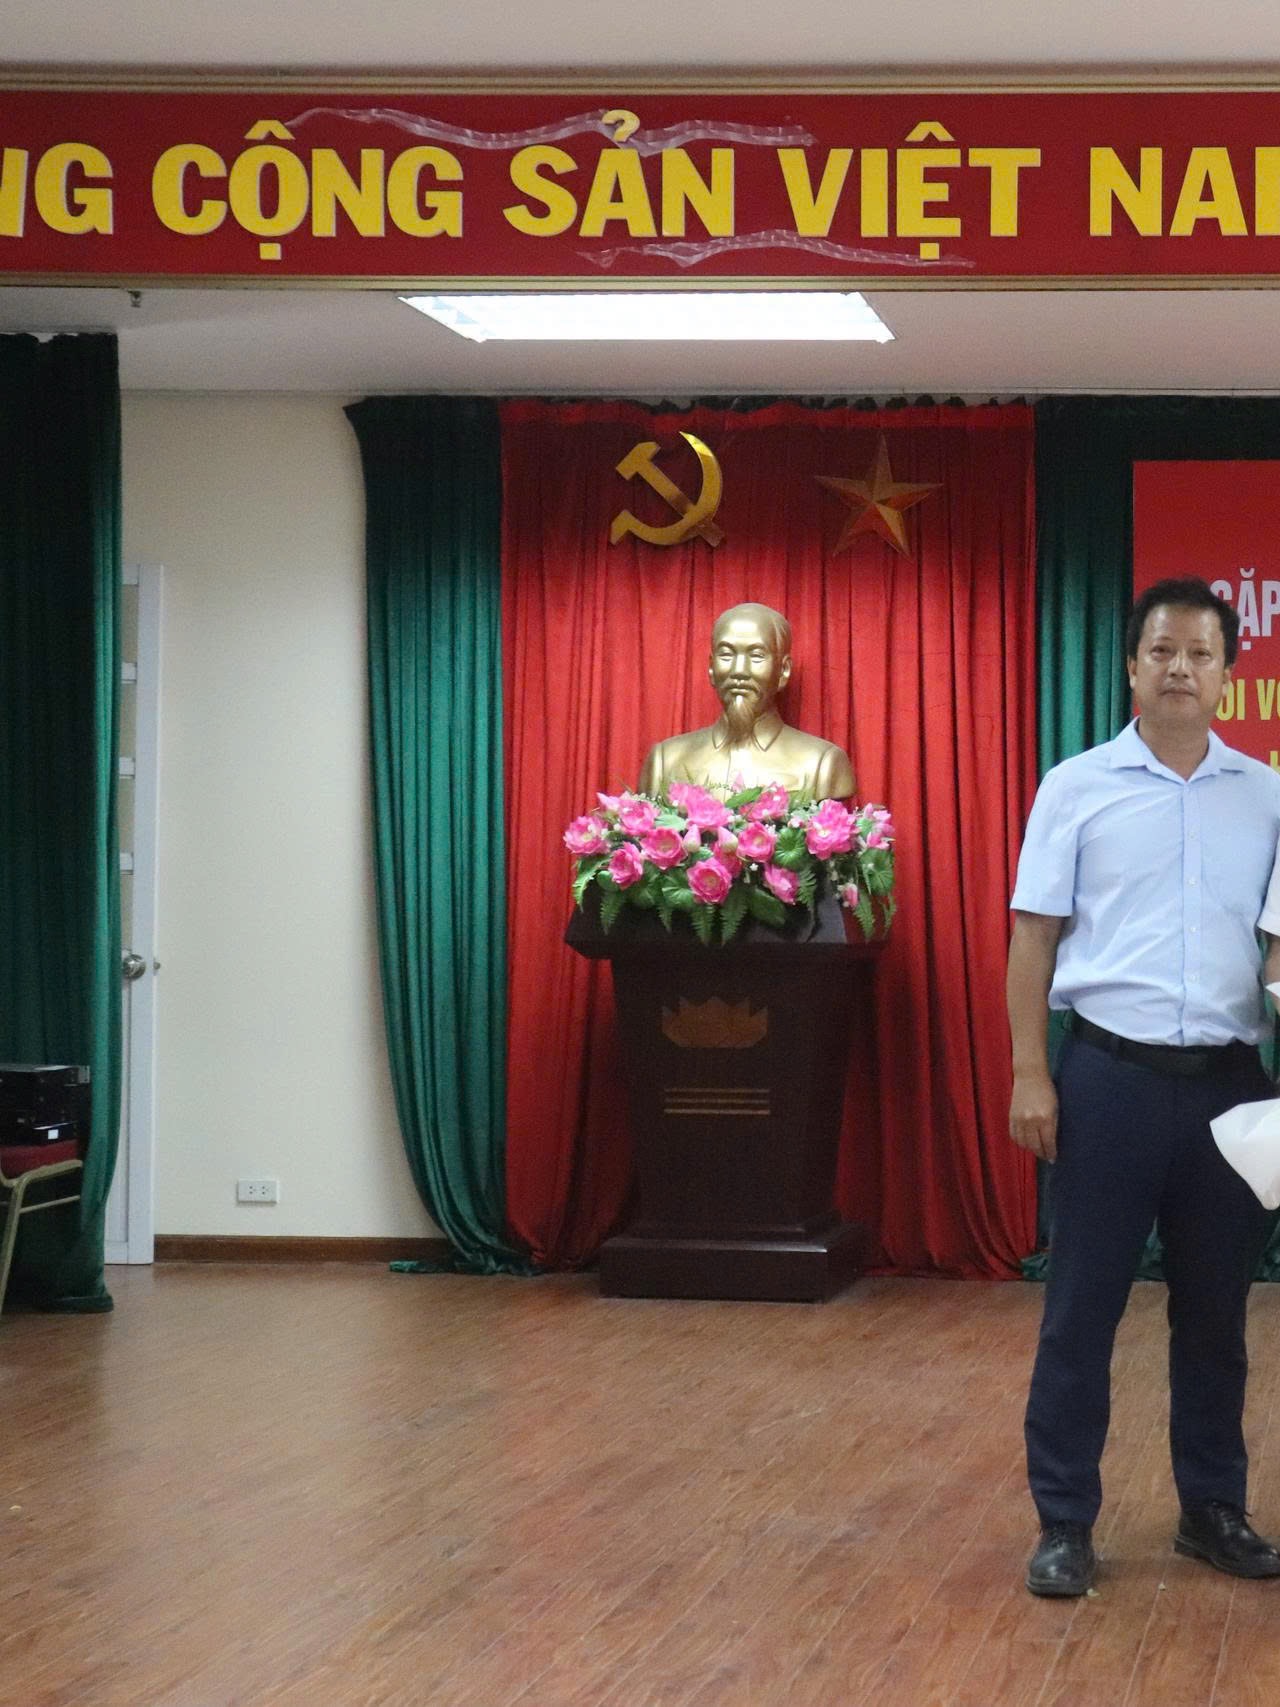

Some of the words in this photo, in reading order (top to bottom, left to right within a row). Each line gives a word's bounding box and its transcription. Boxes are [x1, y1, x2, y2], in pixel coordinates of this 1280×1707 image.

[152, 120, 463, 260] CỘNG
[505, 110, 735, 237] SẢN
[778, 121, 1041, 260] VIỆT
